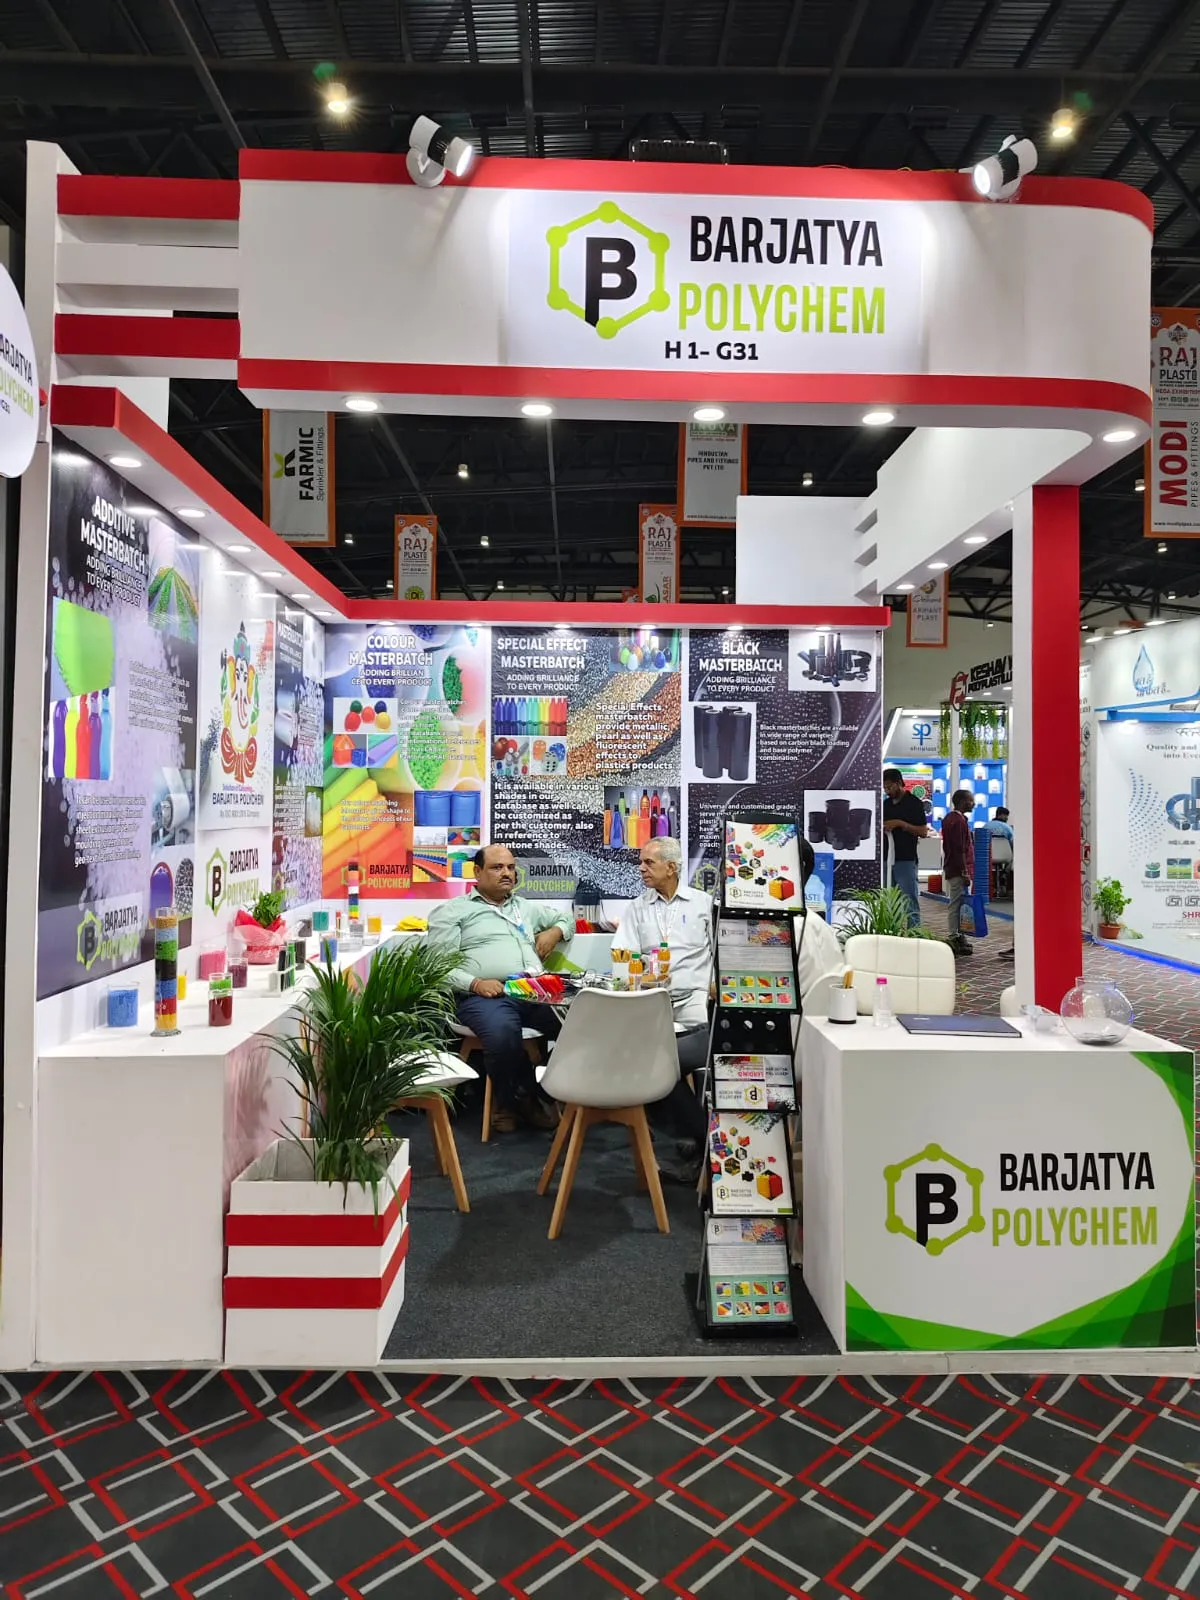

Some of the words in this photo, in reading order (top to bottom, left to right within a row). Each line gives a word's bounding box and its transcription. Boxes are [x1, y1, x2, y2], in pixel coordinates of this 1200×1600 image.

[690, 215, 883, 267] BARJATYA
[678, 283, 885, 334] POLYCHEM
[665, 341, 681, 359] H
[716, 342, 759, 360] G31
[1160, 347, 1197, 369] RAJ
[1191, 422, 1199, 467] FITTINGS
[298, 427, 314, 501] FARMIC
[1159, 421, 1188, 507] MODI
[1191, 481, 1199, 508] PIPES
[94, 495, 135, 540] ADDITIVE
[648, 527, 671, 540] RAJ
[81, 518, 145, 574] MASTERBATCH
[404, 538, 428, 551] RAJ
[87, 571, 96, 585] TO
[367, 635, 416, 649] COLOUR
[497, 637, 545, 650] SPECIAL
[546, 637, 589, 651] EFFECT
[722, 641, 760, 655] BLACK
[349, 651, 433, 666] MASTERBATCH
[501, 655, 586, 669] MASTERBATCH
[699, 658, 783, 672] MASTERBATCH
[360, 669, 390, 677] ADDING
[391, 669, 424, 678] BRILLIAN
[373, 678, 395, 686] EVERY
[543, 683, 579, 691] PRODUCT
[596, 702, 628, 712] Special
[630, 702, 662, 711] Effects
[595, 722, 631, 731] provide
[595, 732, 619, 741] pearl
[633, 732, 651, 740] well
[596, 742, 647, 750] fluorescent
[595, 761, 630, 770] plastics
[494, 782, 502, 790] It
[503, 782, 511, 790] is
[513, 782, 554, 791] available
[494, 792, 527, 800] shades
[528, 792, 538, 800] in
[494, 802, 538, 810] database
[551, 802, 570, 810] well
[507, 812, 560, 820] customized
[494, 823, 509, 832] per
[511, 821, 528, 829] the
[528, 821, 574, 831] customer,
[575, 821, 594, 829] also
[504, 831, 549, 839] reference
[494, 841, 532, 849] antone
[534, 841, 569, 849] shades.
[230, 848, 259, 874] BARJATYA
[369, 864, 410, 875] BARJATYA
[530, 865, 574, 876] BARJATYA
[527, 880, 575, 892] POLYCHEM
[1000, 1152, 1155, 1191] BARJATYA
[992, 1206, 1158, 1246] POLYCHEM
